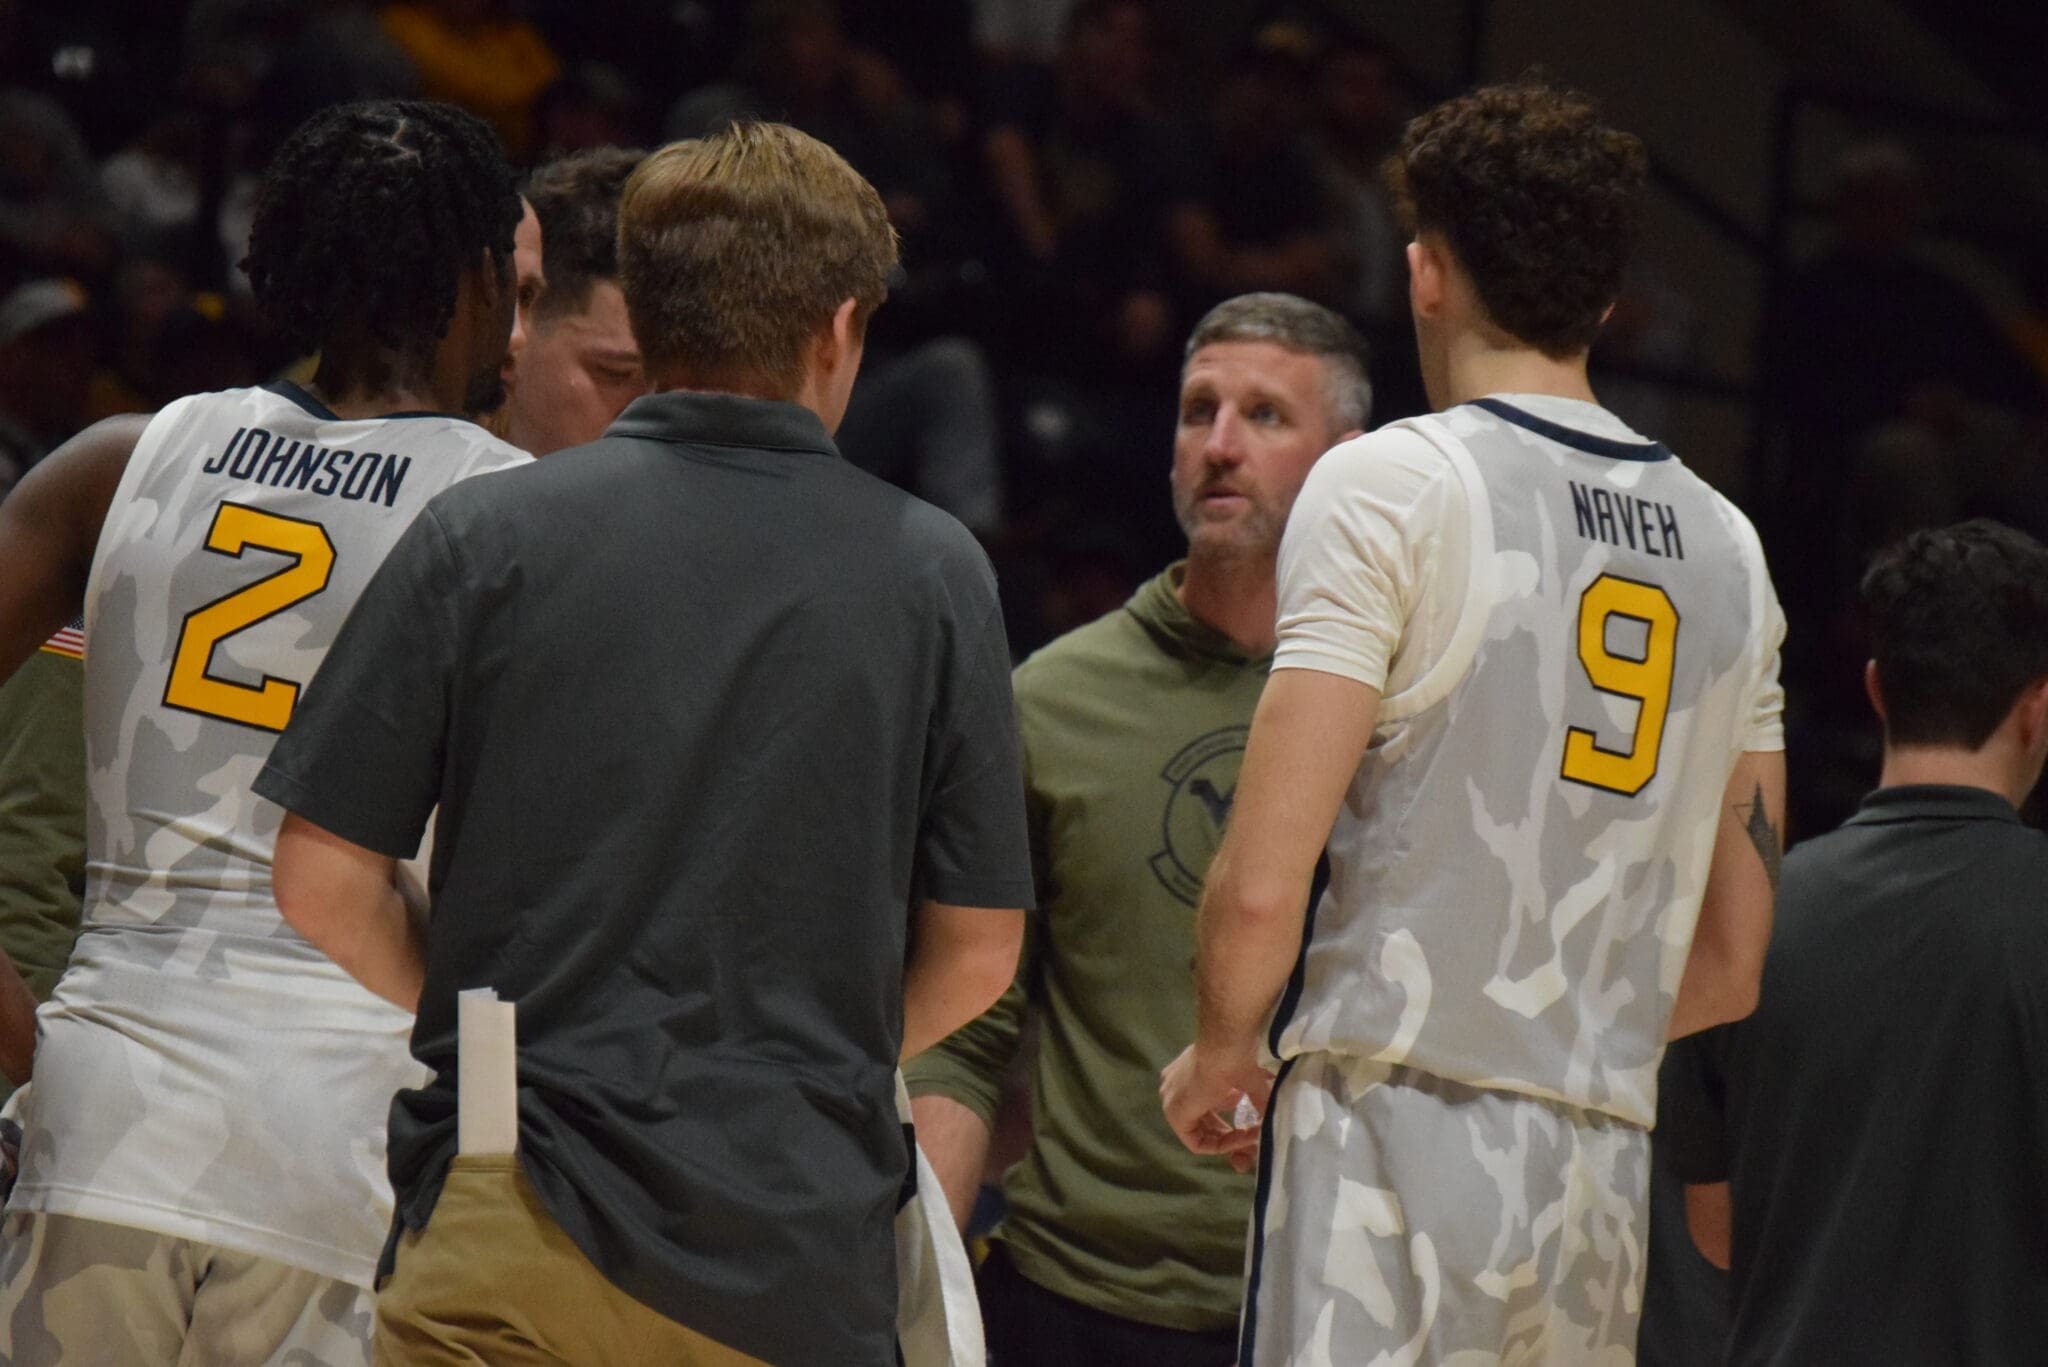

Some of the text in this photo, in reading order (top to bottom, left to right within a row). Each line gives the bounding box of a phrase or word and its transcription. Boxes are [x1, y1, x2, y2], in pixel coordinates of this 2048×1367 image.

[203, 427, 412, 507] JOHNSON
[1569, 480, 1684, 560] NAVEH
[162, 500, 337, 733] 2
[1560, 572, 1680, 798] 9
